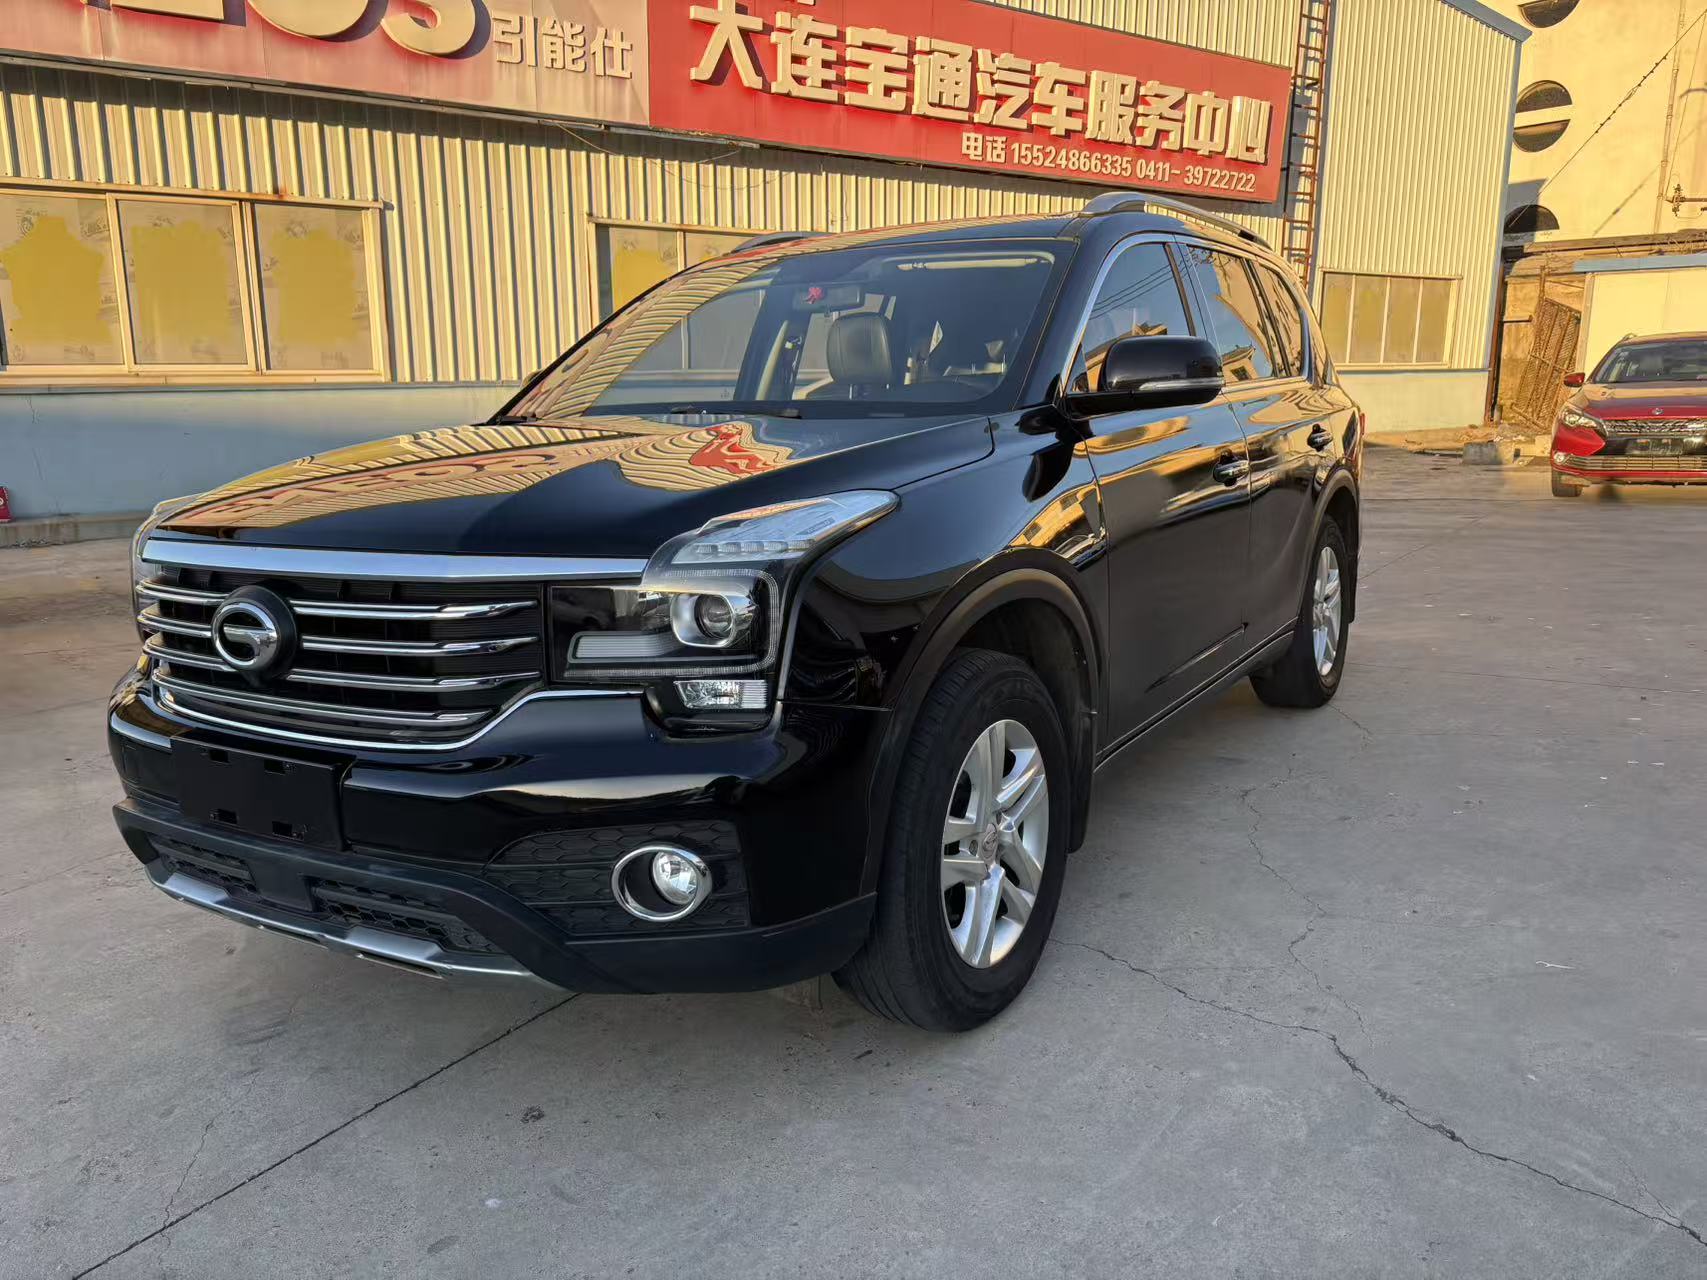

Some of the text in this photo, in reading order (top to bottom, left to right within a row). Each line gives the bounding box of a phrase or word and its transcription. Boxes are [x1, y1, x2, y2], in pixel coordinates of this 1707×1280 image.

[492, 11, 632, 79] 引能仕
[689, 0, 1271, 163] 大连宝通汽车服务中心
[961, 132, 1006, 163] 电话
[1011, 143, 1132, 177] 15524866335
